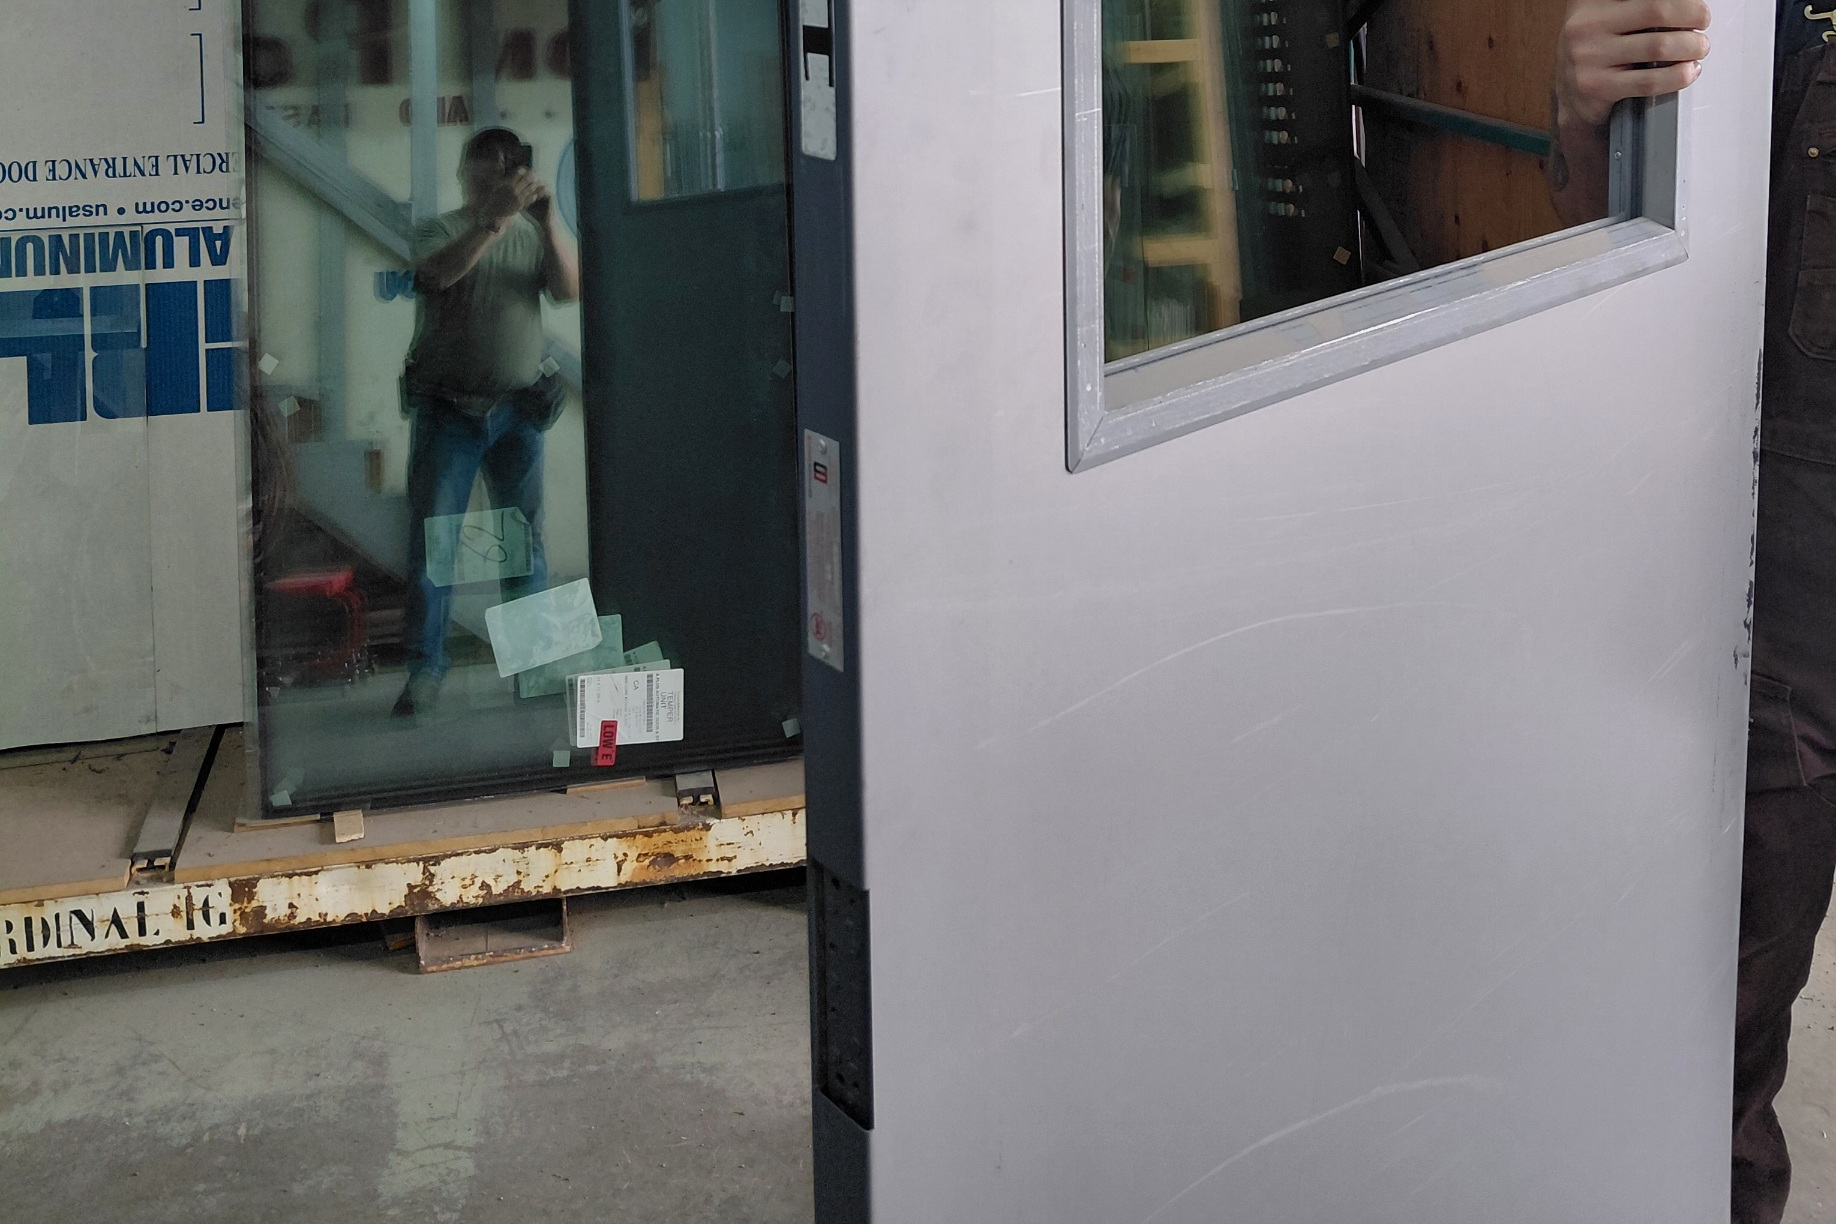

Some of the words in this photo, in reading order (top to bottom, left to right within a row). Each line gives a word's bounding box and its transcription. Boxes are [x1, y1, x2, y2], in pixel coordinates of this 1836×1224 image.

[45, 155, 160, 183] ENTRANCE
[0, 201, 108, 222] usalum.c
[0, 225, 234, 278] ALUMINU
[602, 724, 615, 749] LOW
